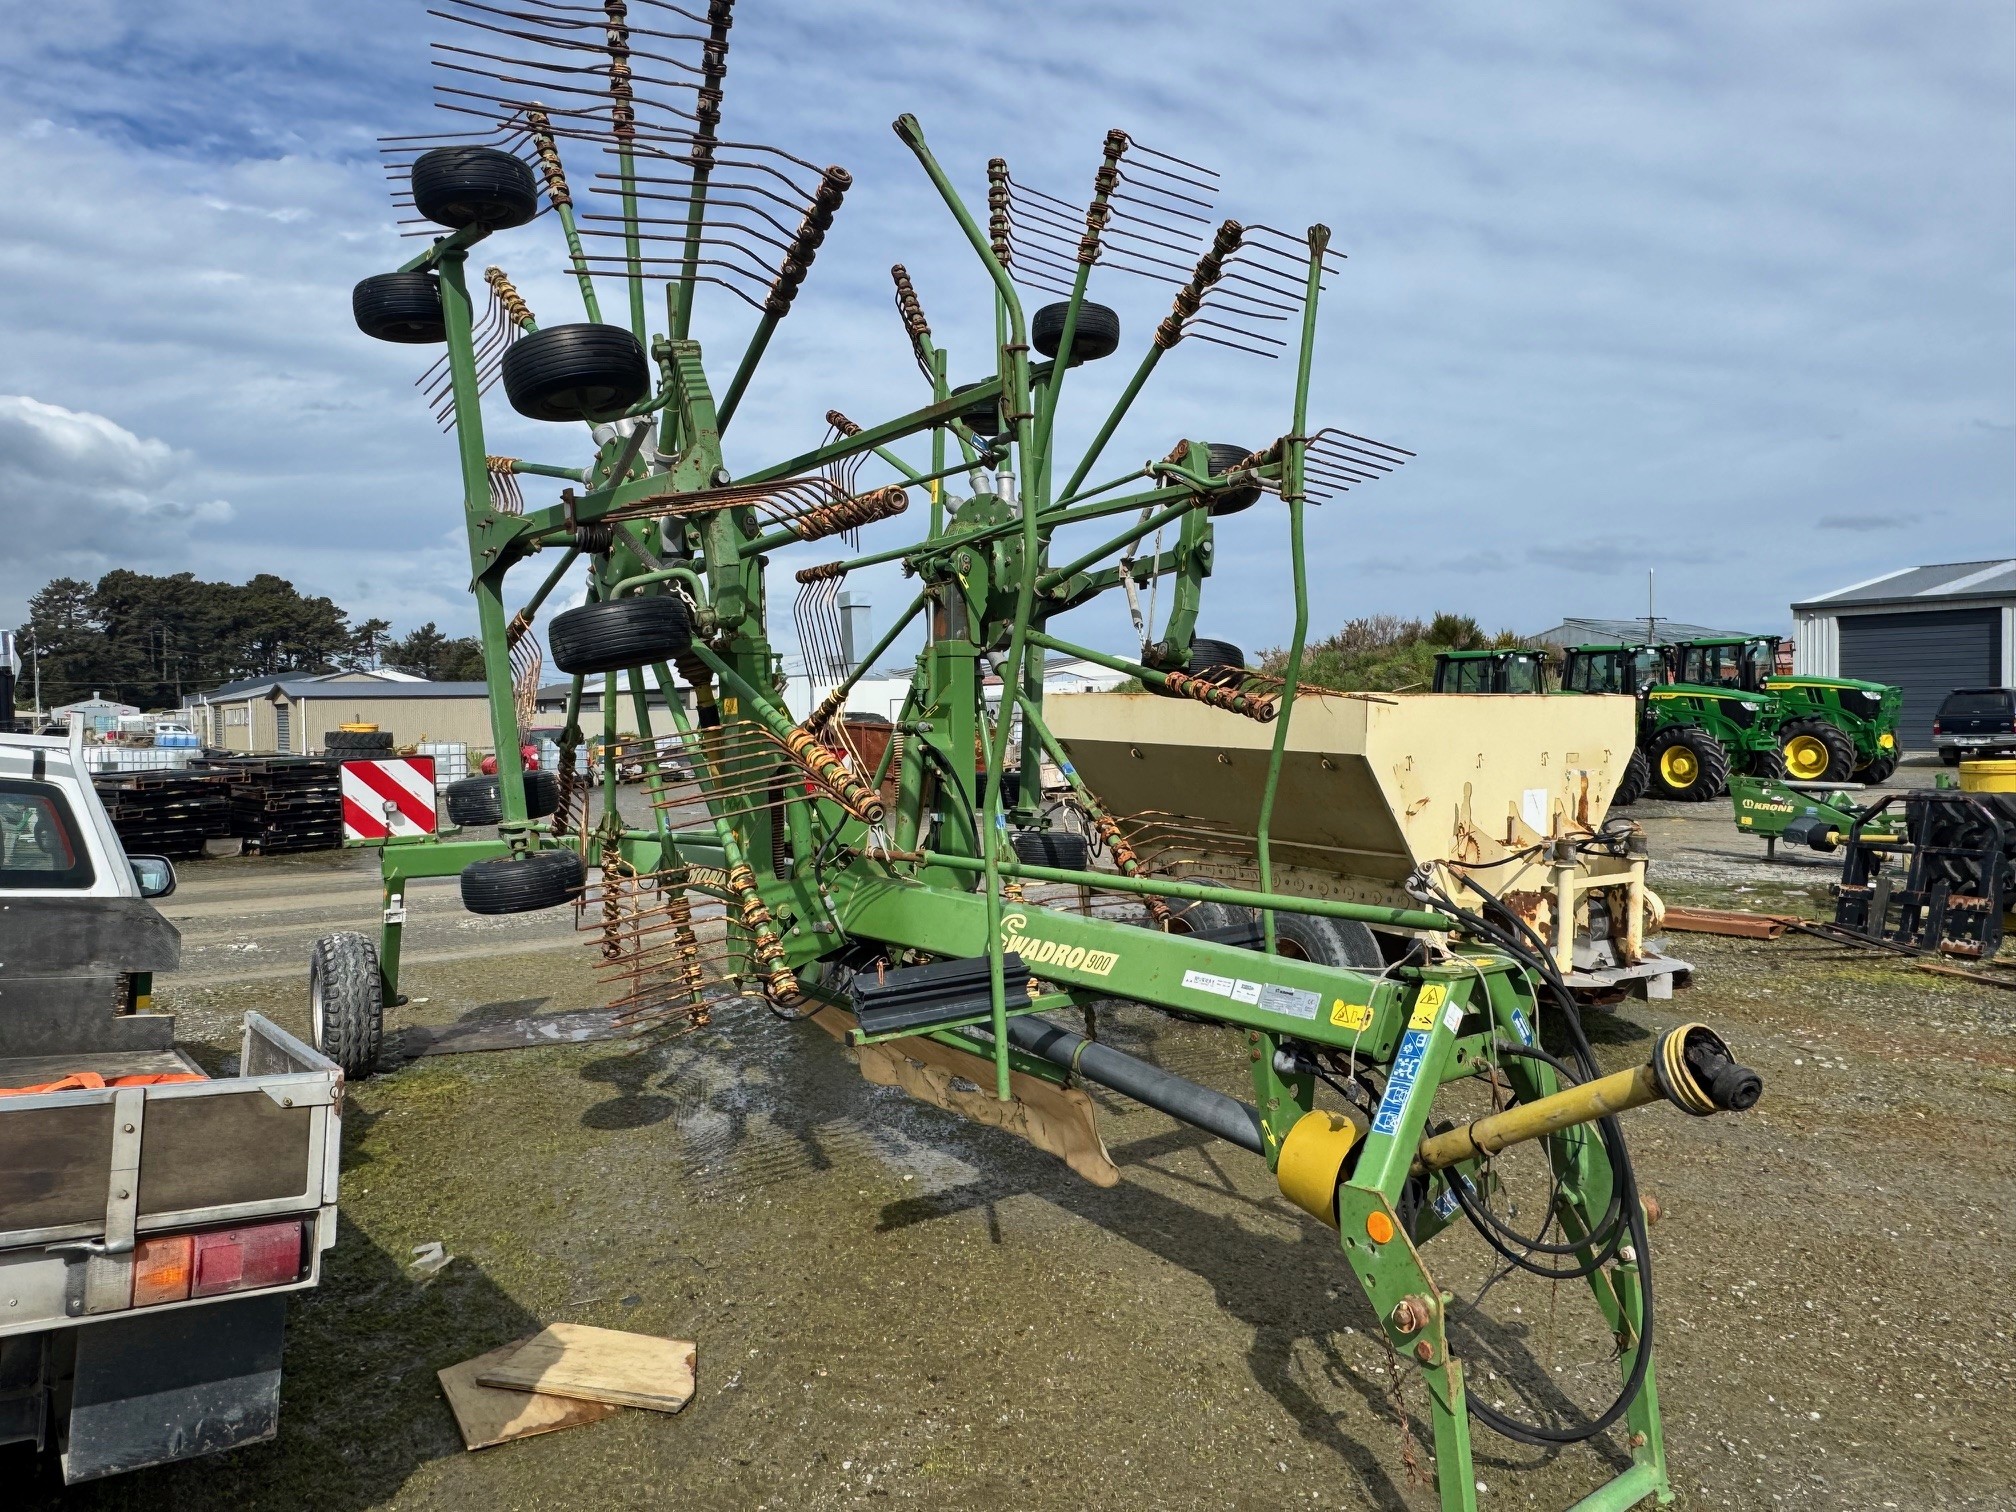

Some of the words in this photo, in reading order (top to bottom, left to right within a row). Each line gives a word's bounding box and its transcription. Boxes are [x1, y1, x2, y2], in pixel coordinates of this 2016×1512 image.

[1754, 802, 1795, 813] KRONE
[988, 913, 1087, 969] SWADRO
[1086, 954, 1113, 972] 900
